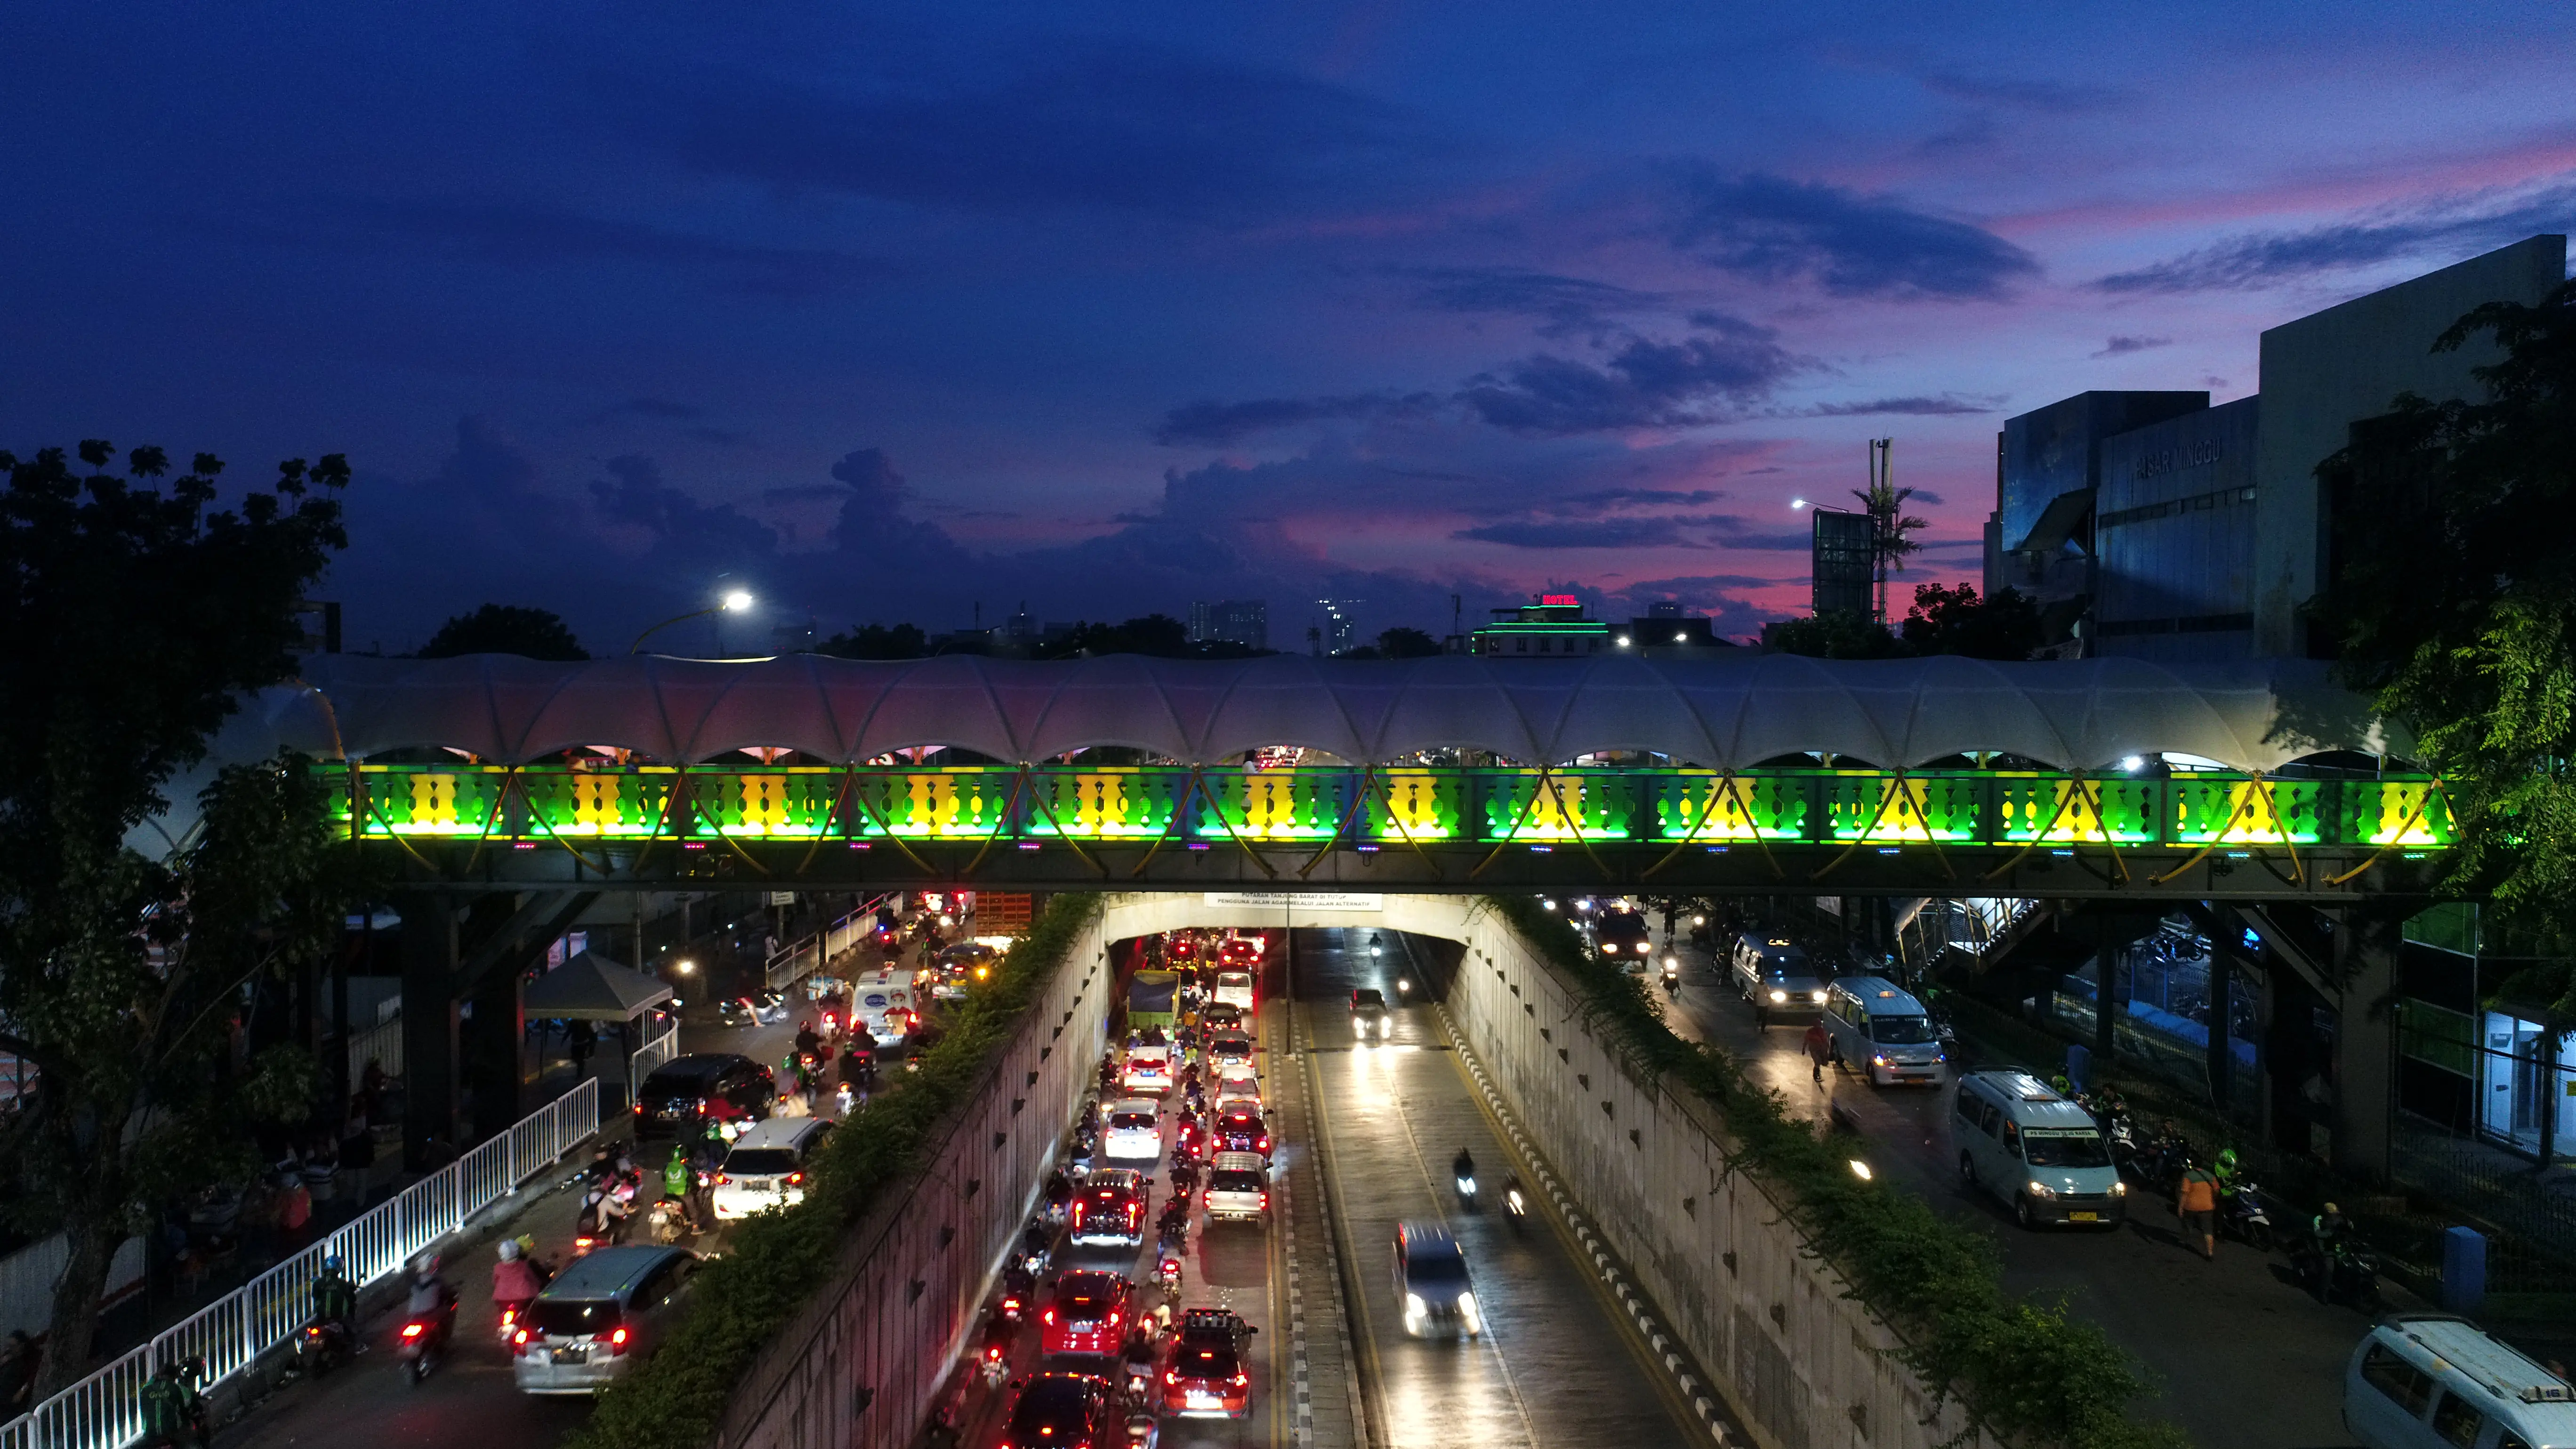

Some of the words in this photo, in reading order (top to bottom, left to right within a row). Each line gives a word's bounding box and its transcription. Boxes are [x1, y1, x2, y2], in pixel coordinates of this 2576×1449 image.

[2137, 451, 2170, 478] PASAR
[2174, 437, 2222, 471] MINGGU
[1543, 595, 1578, 605] HOTEL
